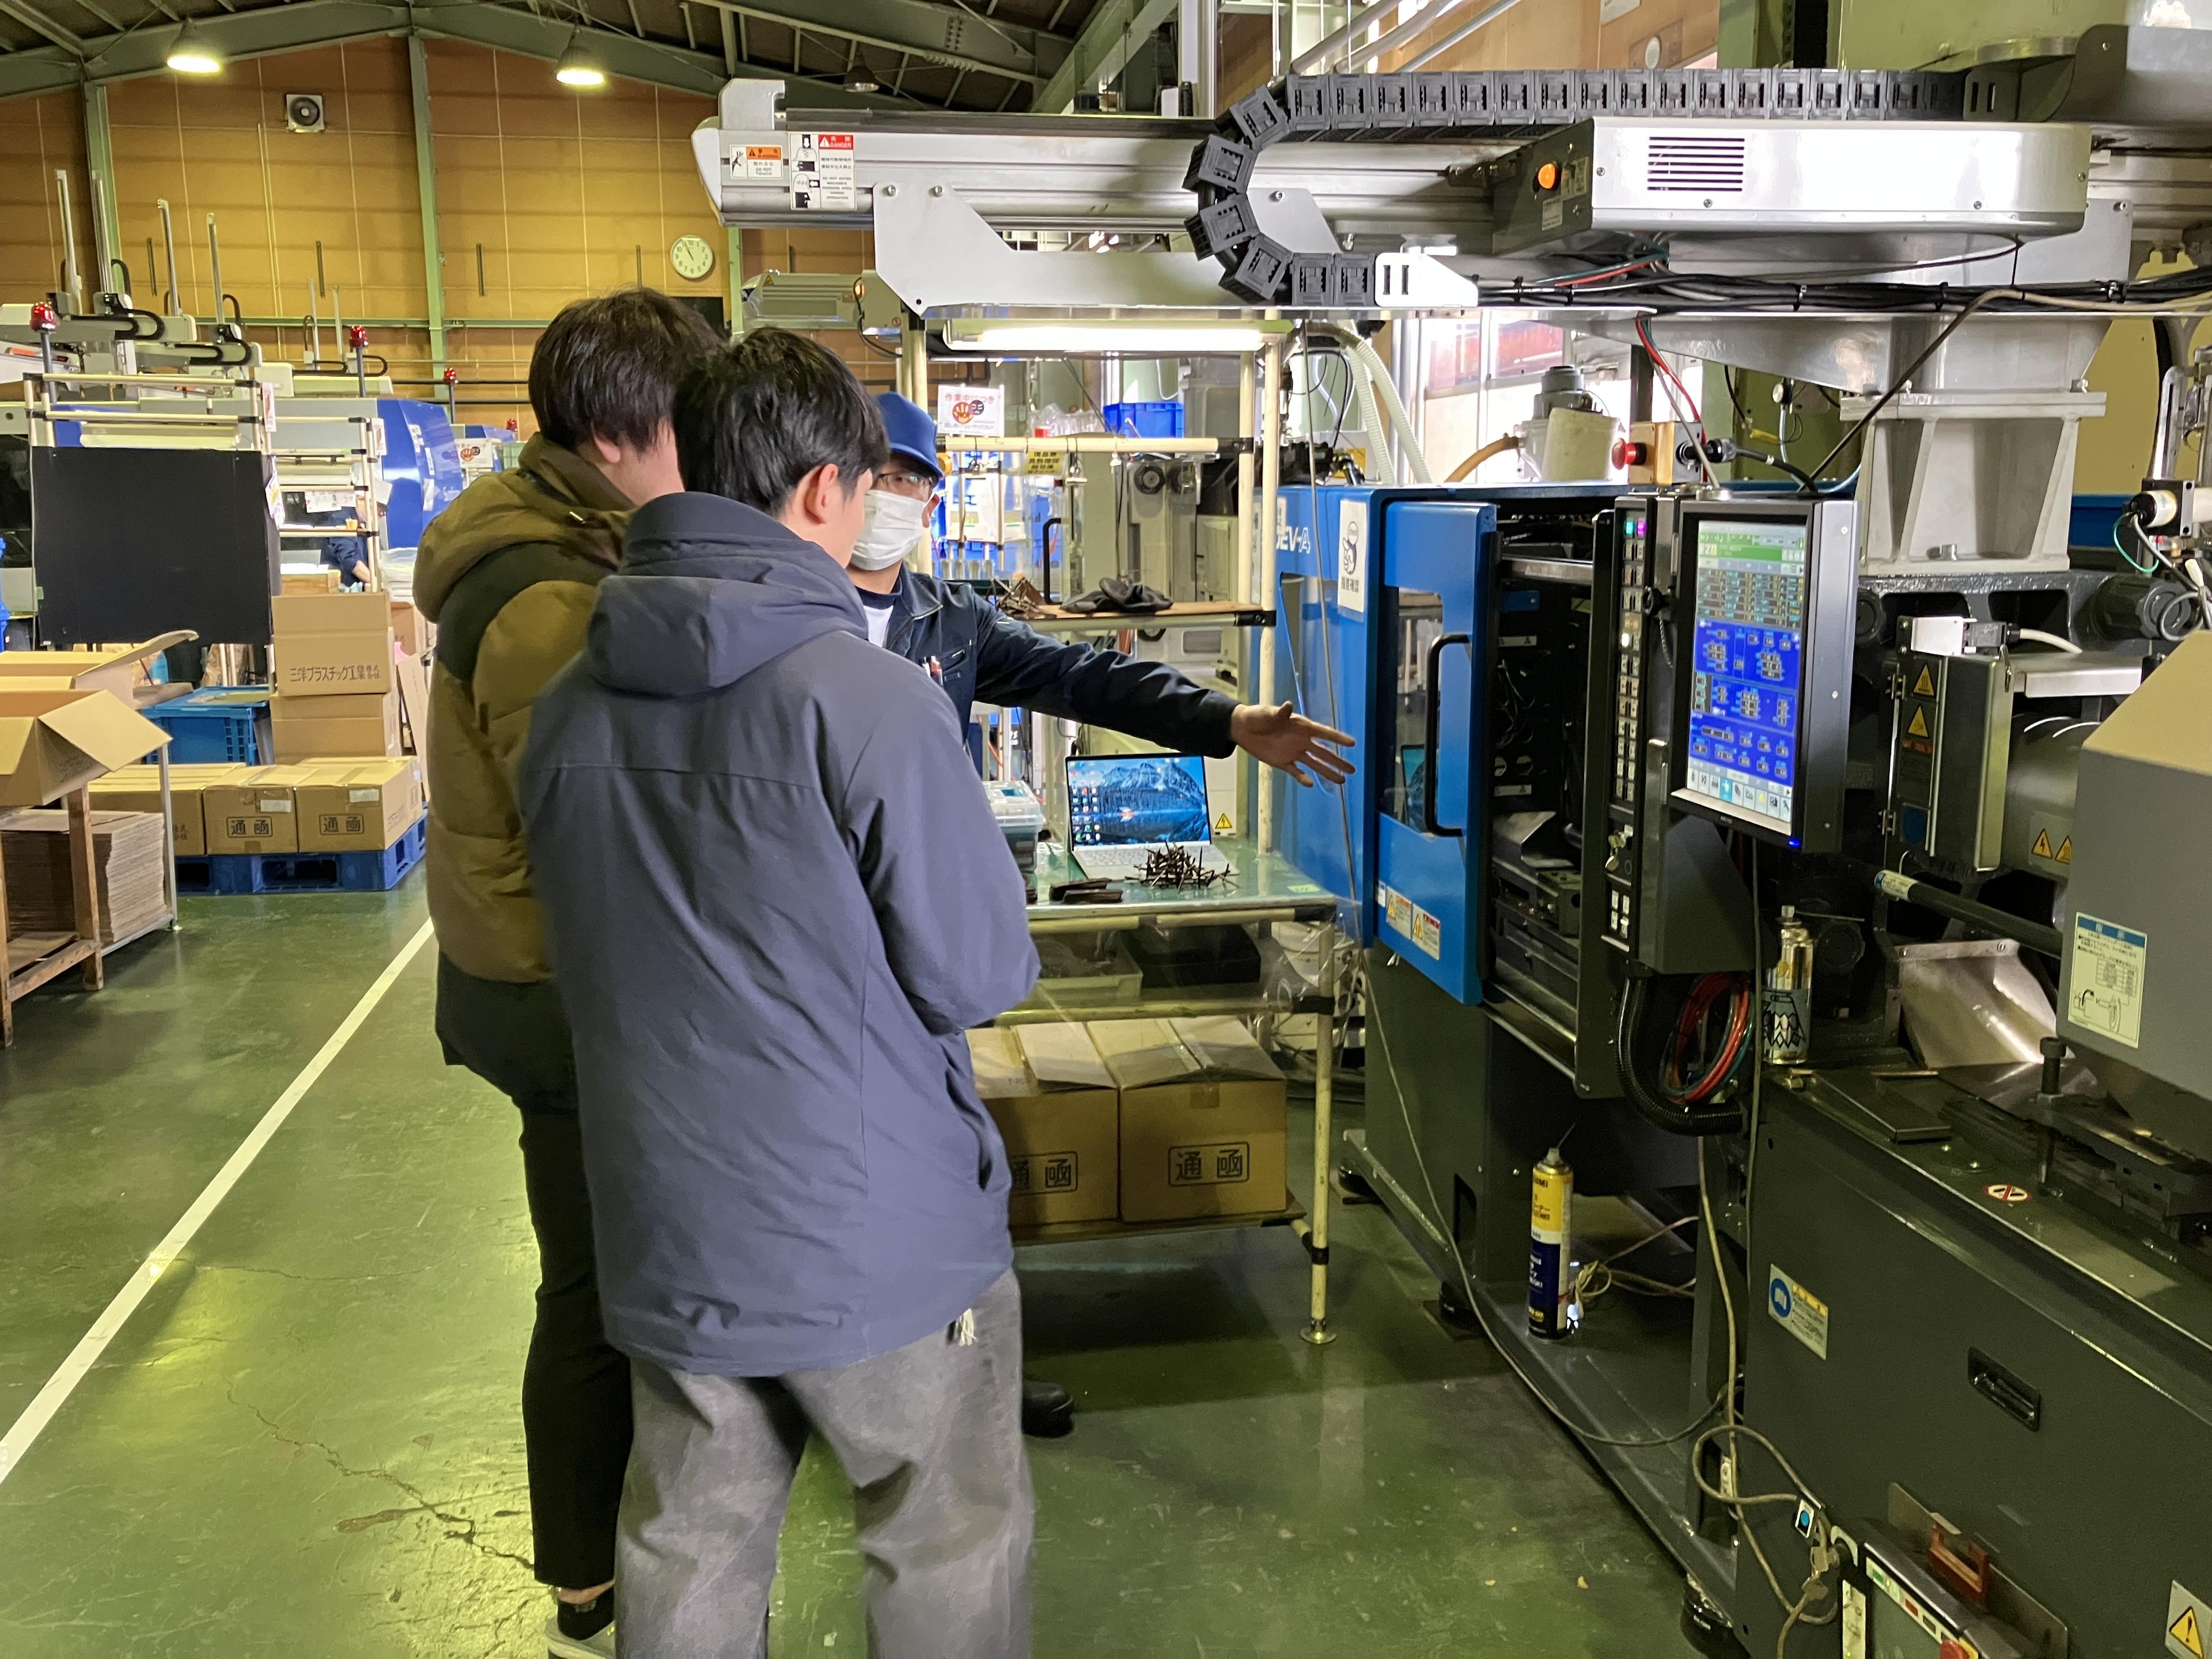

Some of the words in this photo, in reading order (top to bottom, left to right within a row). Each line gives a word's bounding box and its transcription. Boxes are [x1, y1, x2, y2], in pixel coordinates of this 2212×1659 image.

[945, 393, 994, 404] 作業中につき
